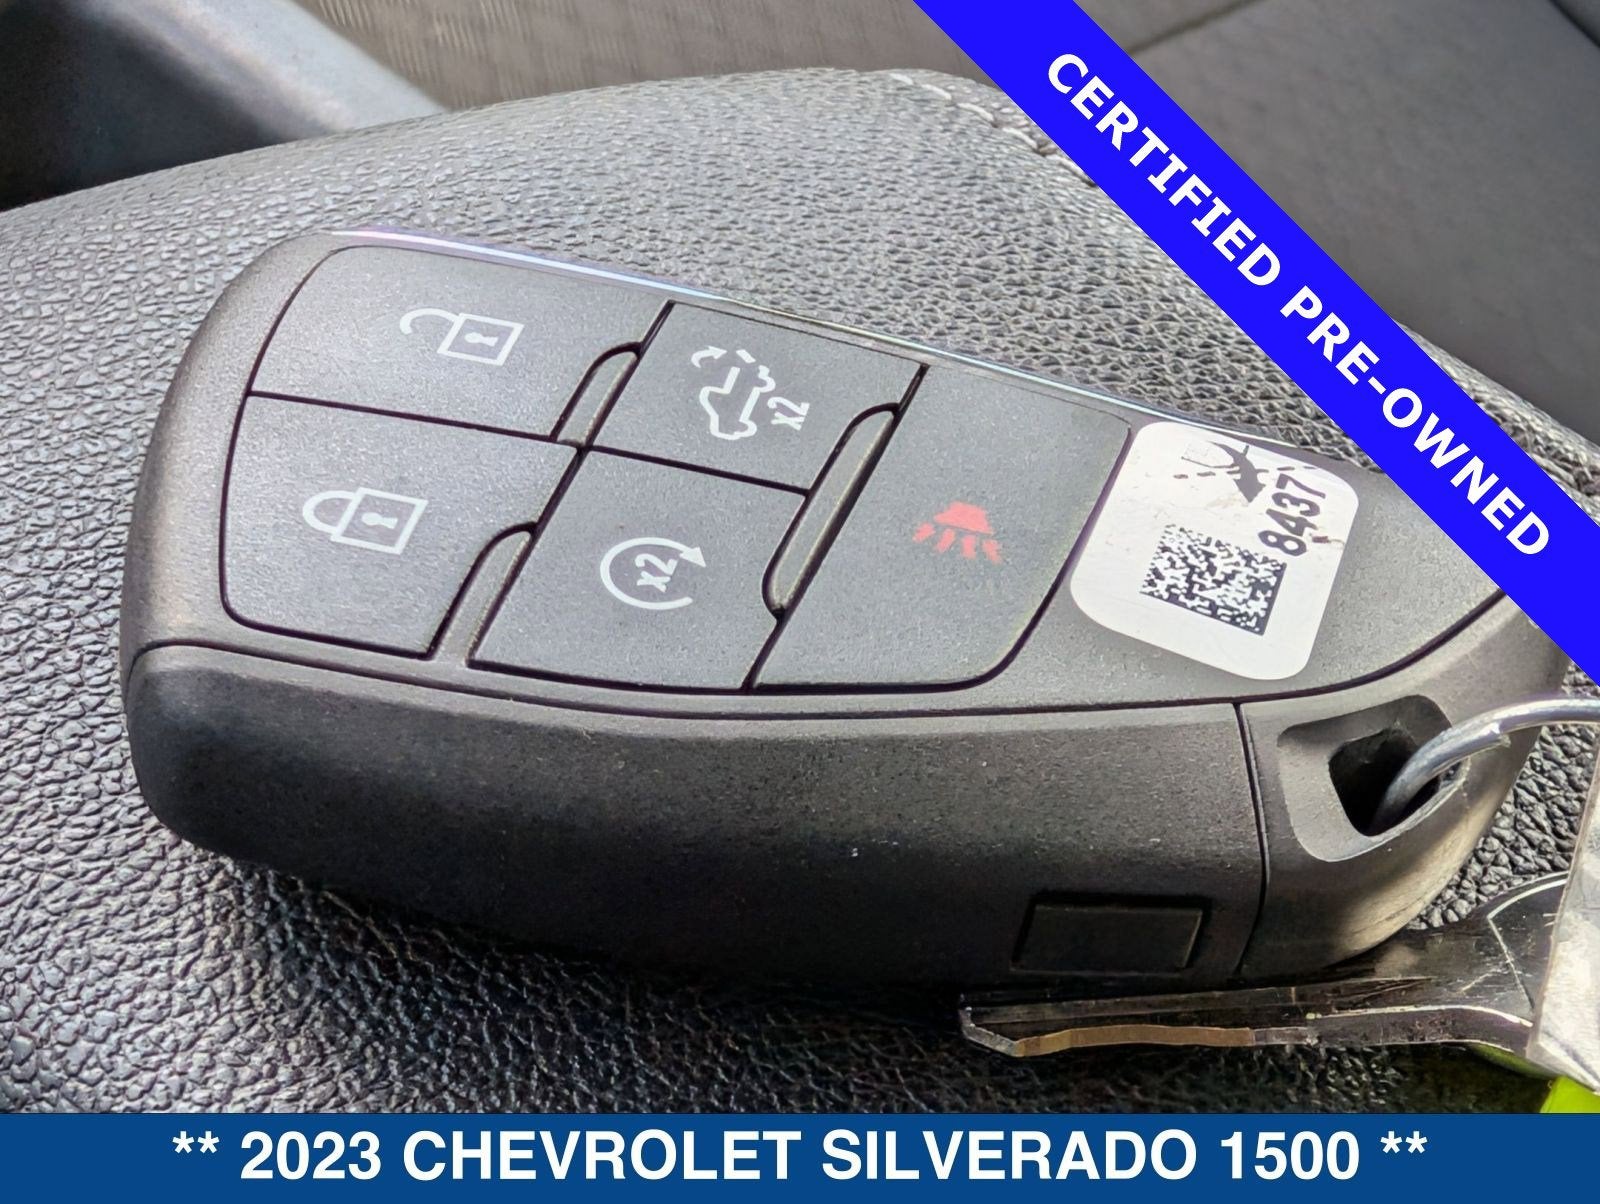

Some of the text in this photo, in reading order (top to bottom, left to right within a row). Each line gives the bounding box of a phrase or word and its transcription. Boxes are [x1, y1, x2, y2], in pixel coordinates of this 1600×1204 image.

[767, 396, 810, 431] x2
[1257, 472, 1326, 557] 8437
[634, 552, 679, 593] x2
